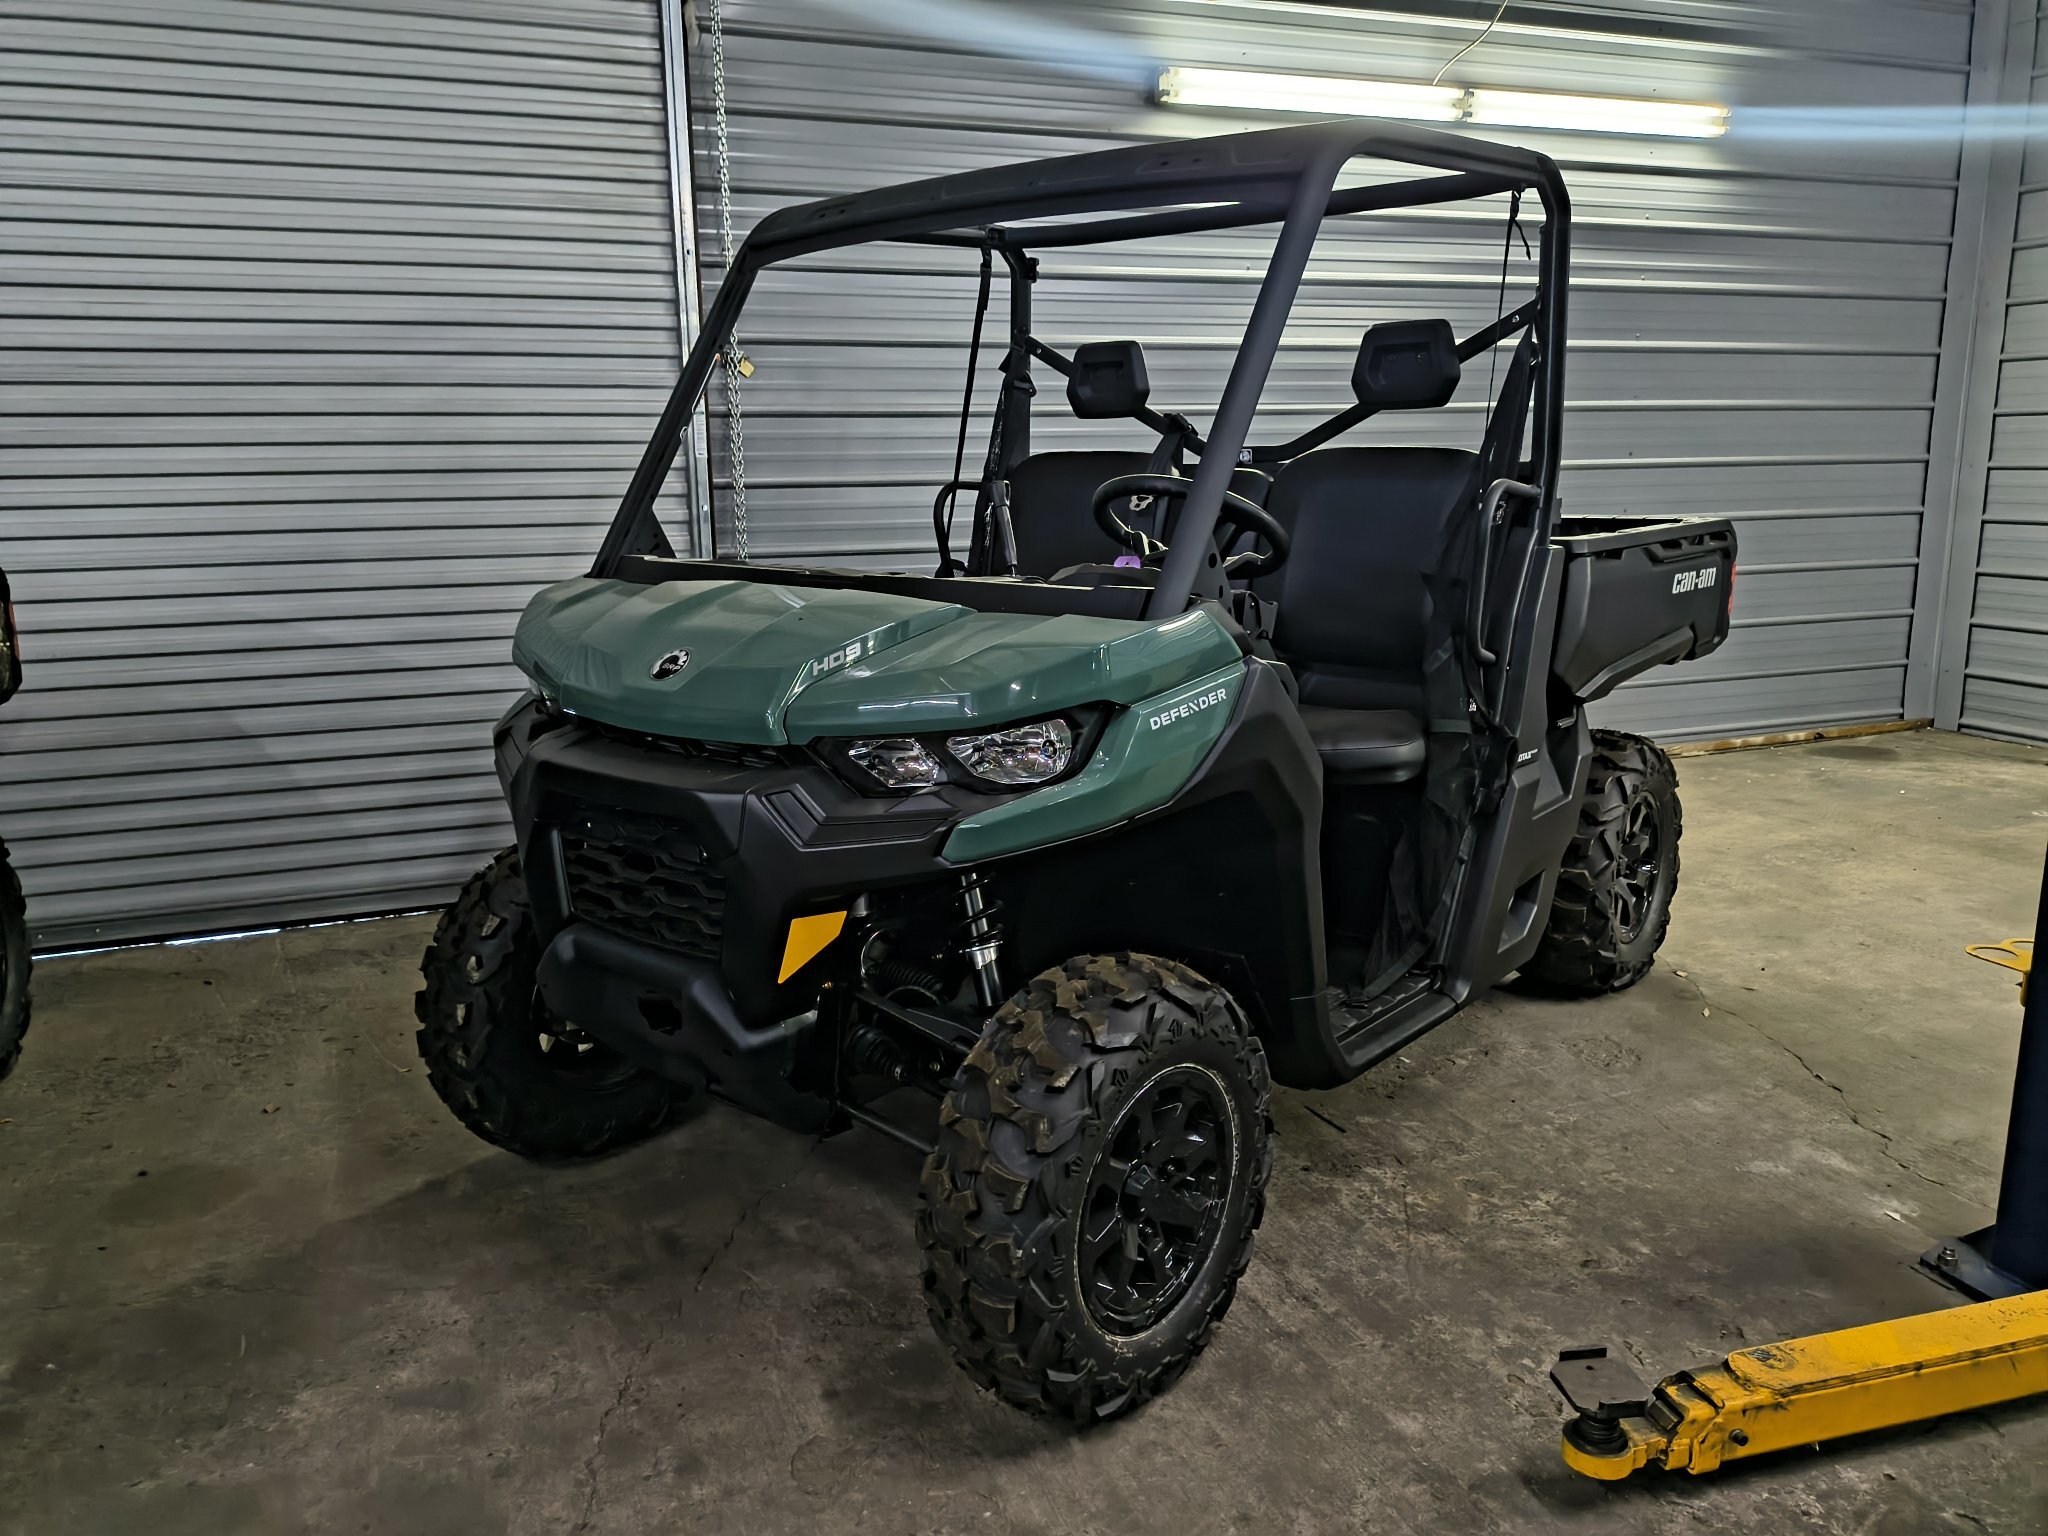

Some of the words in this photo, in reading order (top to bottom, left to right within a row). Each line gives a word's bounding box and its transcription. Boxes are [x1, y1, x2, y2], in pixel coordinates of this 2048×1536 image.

[1672, 566, 1717, 595] can-am
[661, 662, 681, 671] BRP
[812, 642, 861, 677] HD9
[1149, 688, 1227, 731] DEFENDER
